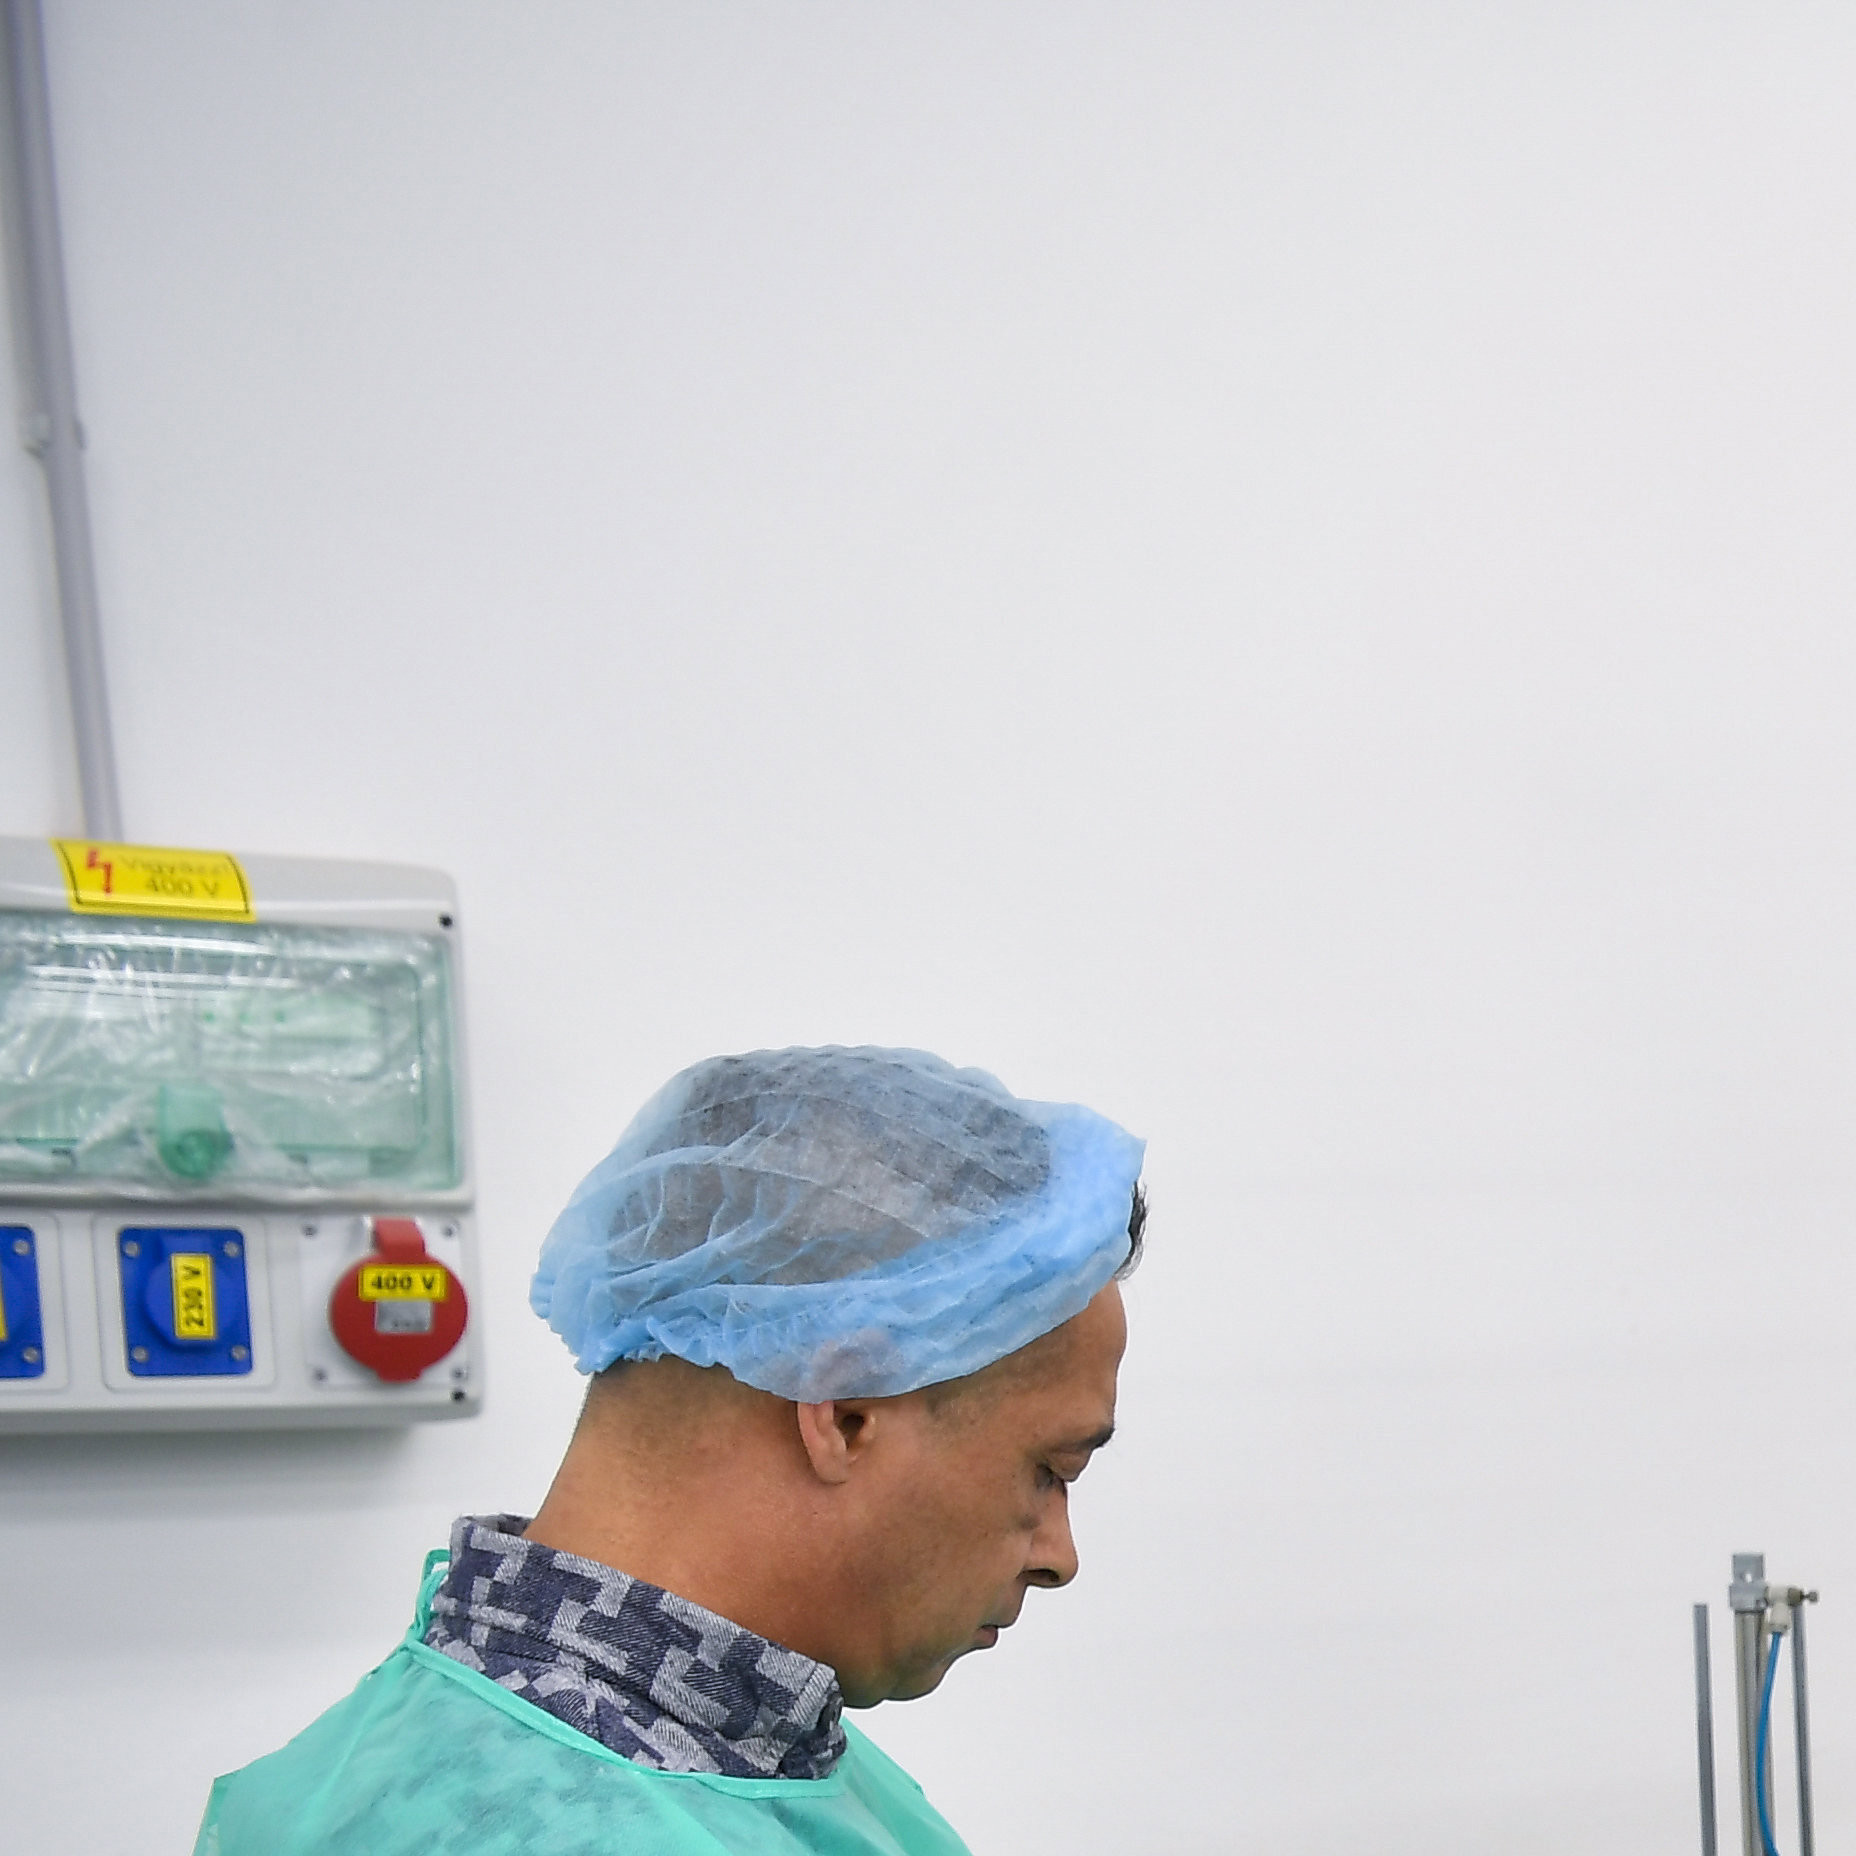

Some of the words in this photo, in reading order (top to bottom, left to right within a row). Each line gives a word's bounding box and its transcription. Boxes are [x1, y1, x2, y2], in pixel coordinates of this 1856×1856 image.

[146, 878, 195, 895] 400
[202, 880, 219, 898] V
[183, 1265, 201, 1281] V
[371, 1275, 412, 1290] 400
[422, 1275, 435, 1290] V
[183, 1287, 204, 1327] 230
